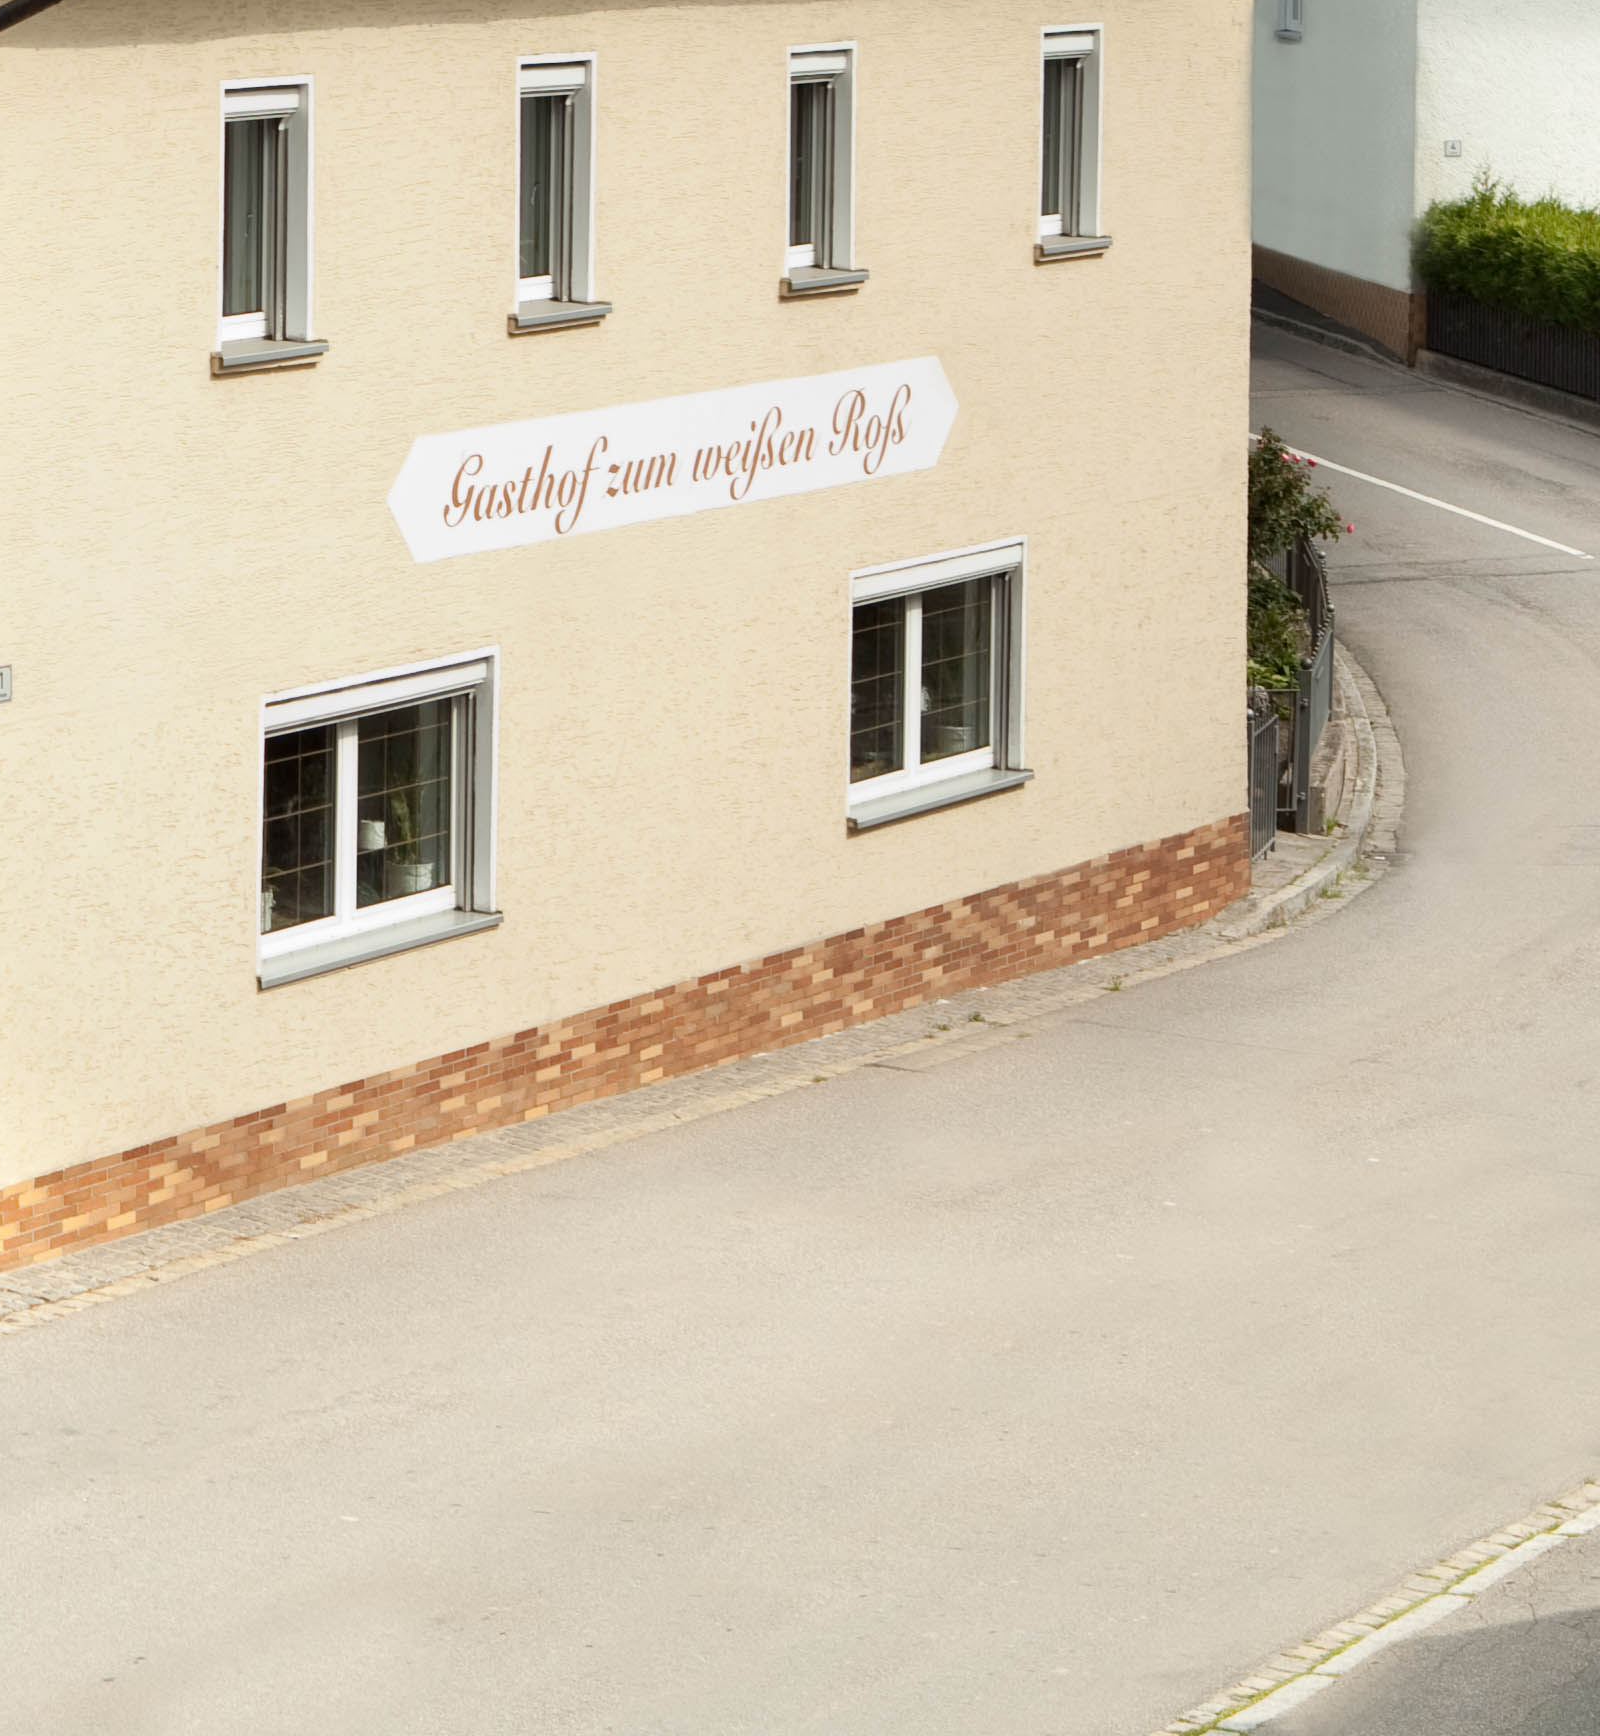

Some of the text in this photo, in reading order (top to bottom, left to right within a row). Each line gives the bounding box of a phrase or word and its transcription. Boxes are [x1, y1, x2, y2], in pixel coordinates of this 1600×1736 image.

[443, 383, 912, 535] Gasthof zum weißen Roß
